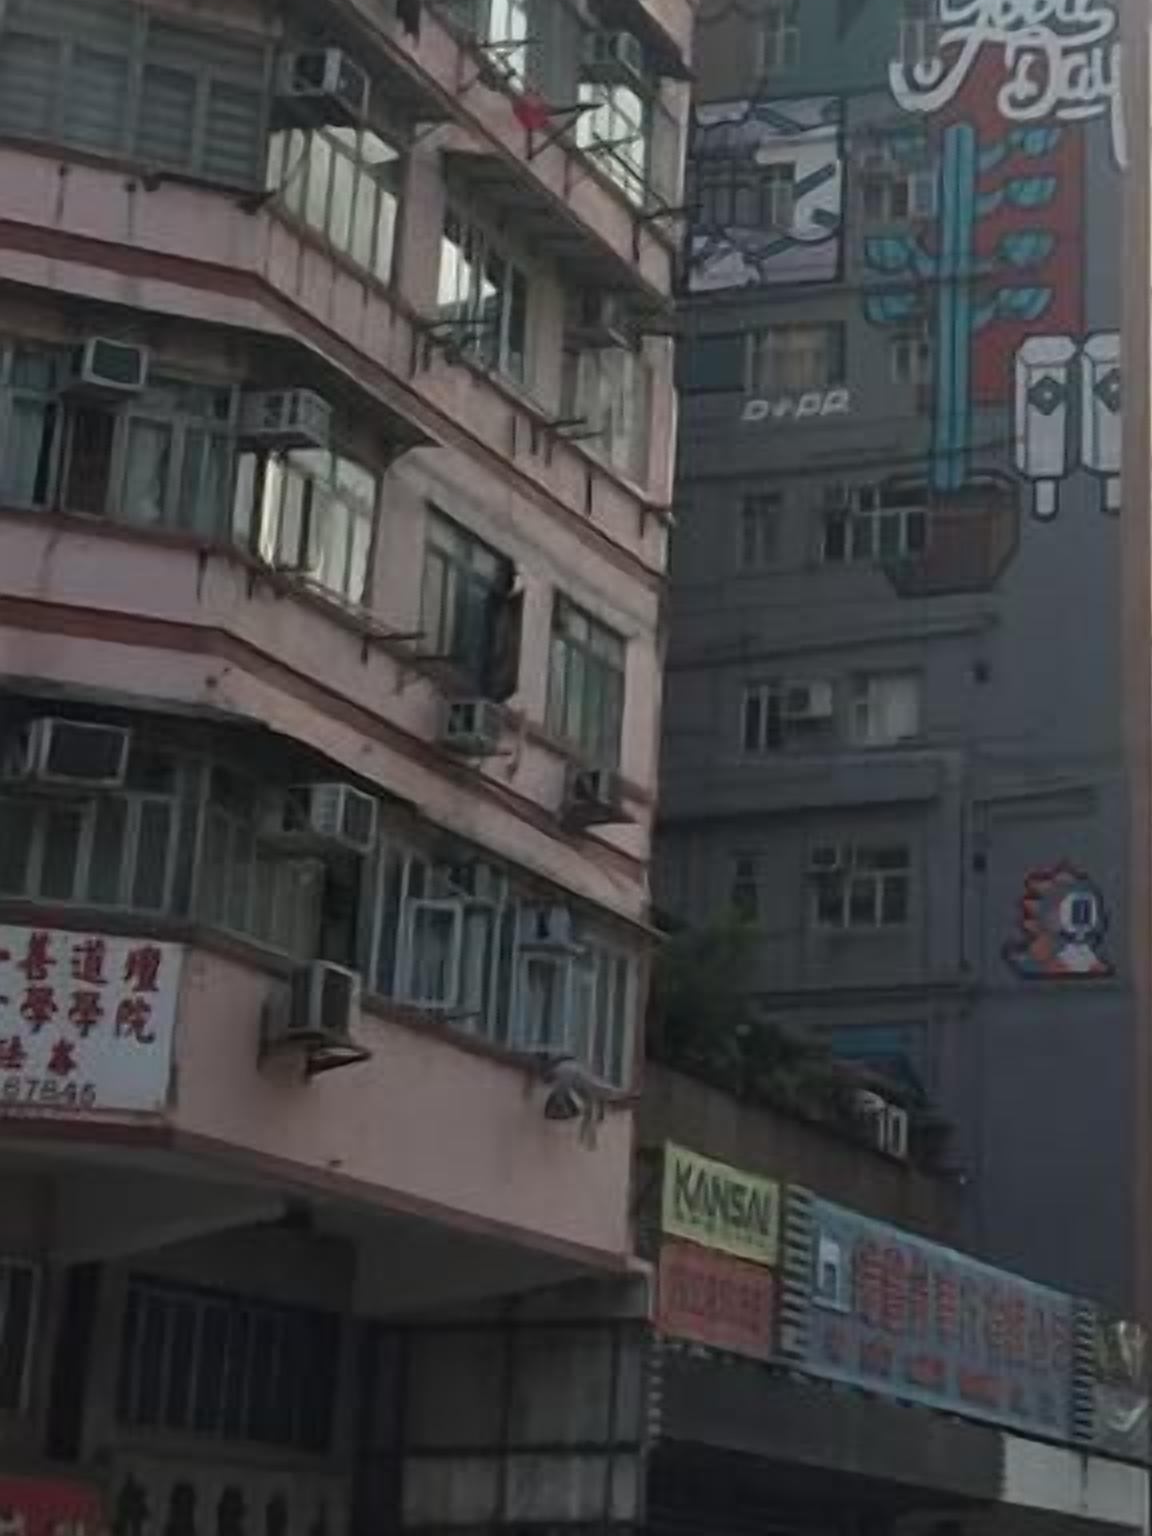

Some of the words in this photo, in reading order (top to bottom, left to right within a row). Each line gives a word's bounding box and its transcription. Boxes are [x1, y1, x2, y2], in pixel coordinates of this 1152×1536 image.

[998, 25, 1127, 171] Day
[0, 932, 162, 992] 善道壇
[674, 1157, 770, 1237] KANSAI
